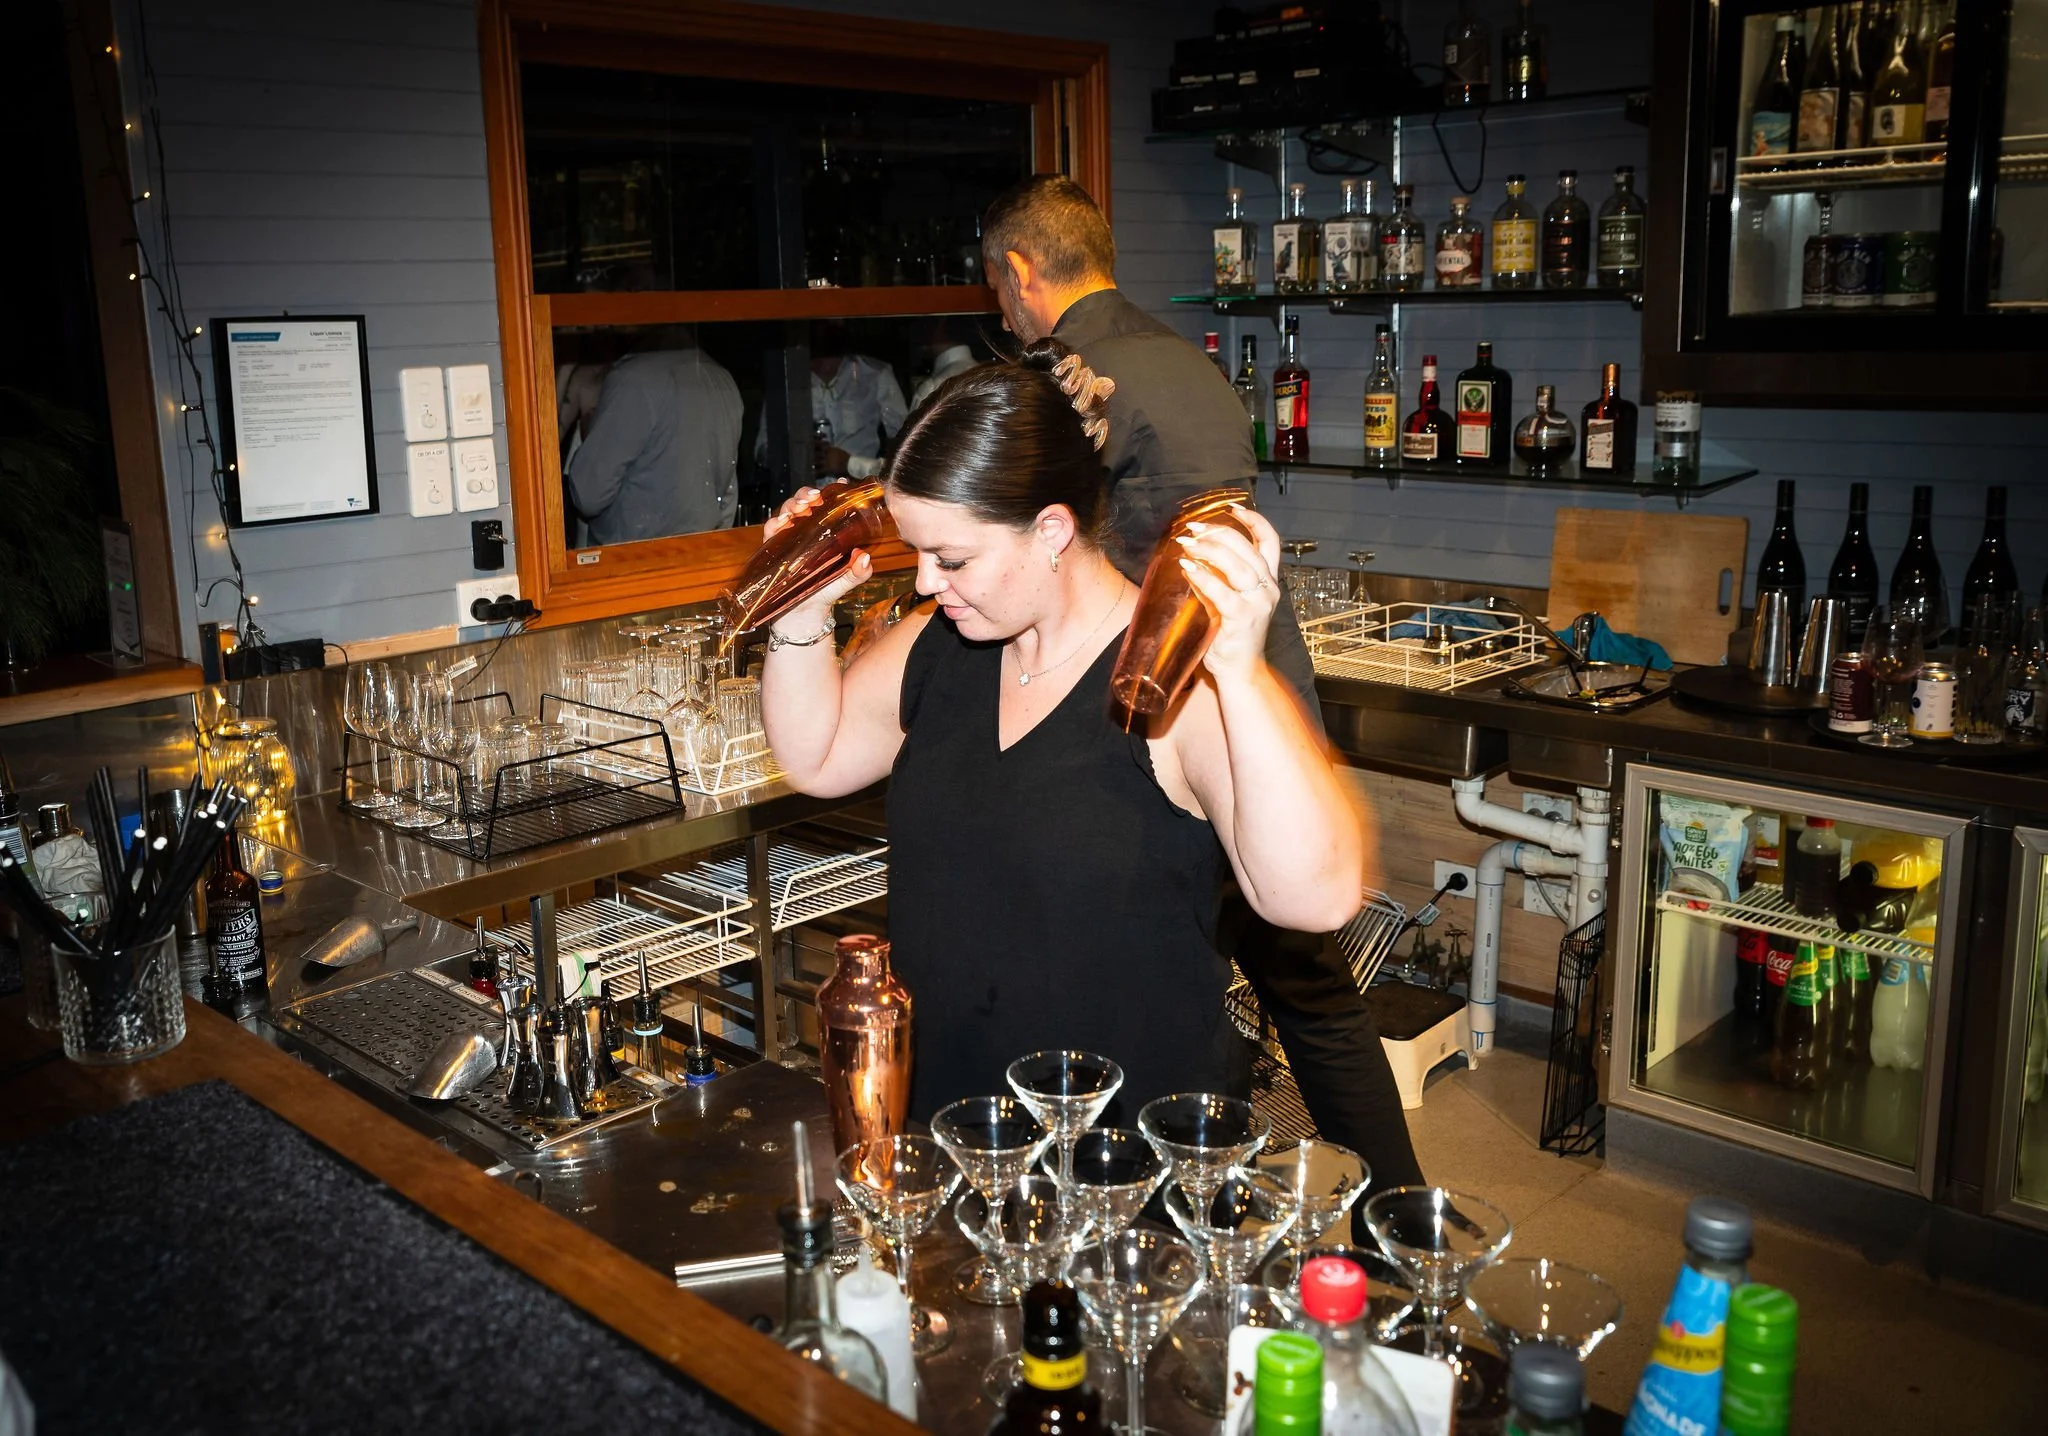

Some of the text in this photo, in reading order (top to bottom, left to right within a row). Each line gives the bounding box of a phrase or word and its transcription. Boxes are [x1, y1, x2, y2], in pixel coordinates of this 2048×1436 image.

[1696, 845, 1719, 860] EGG
[1674, 853, 1714, 869] WHITES
[1767, 950, 1793, 970] Coca
